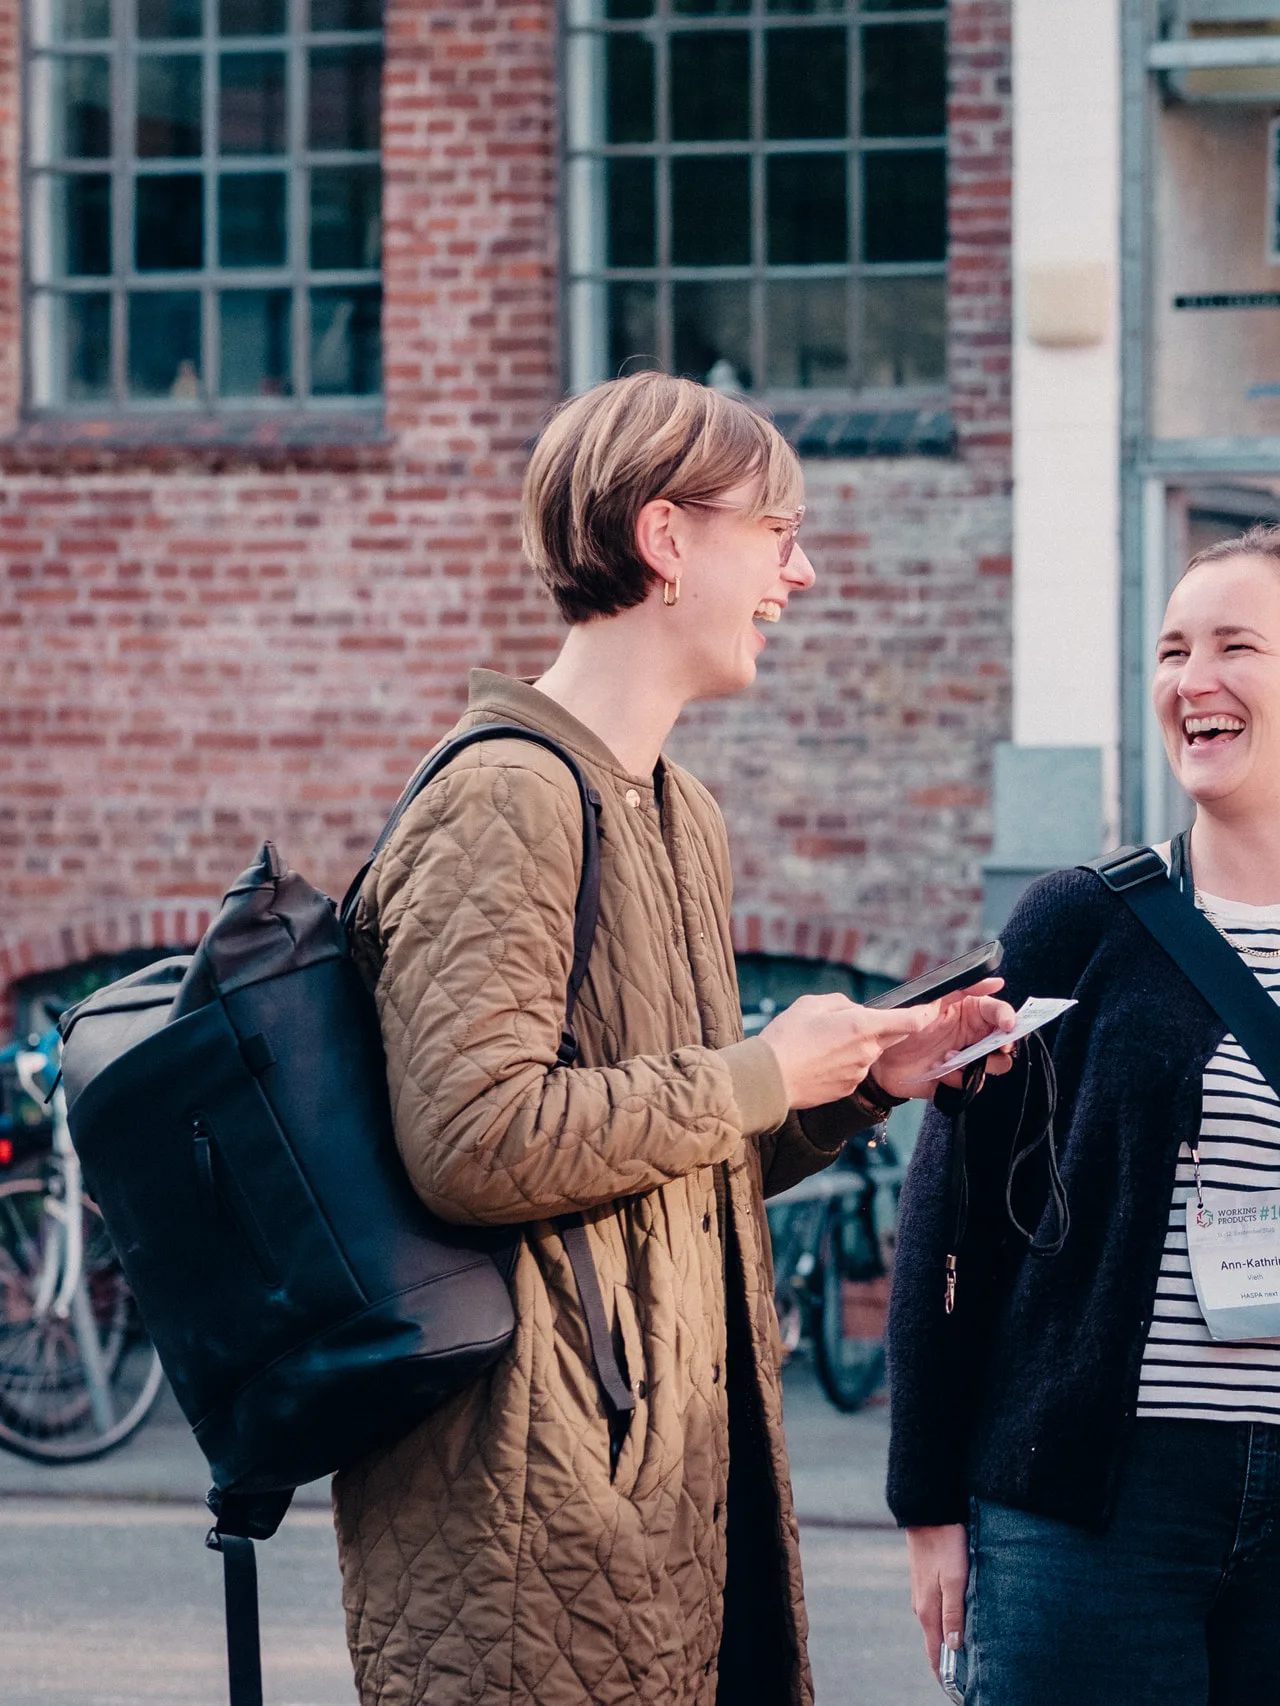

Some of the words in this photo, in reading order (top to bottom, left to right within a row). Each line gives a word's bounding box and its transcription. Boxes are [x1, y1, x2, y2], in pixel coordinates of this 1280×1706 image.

[1217, 1207, 1257, 1217] WORKING
[1217, 1215, 1257, 1225] PRODUCTS
[1240, 1291, 1263, 1300] HASPA
[1264, 1290, 1279, 1298] next
